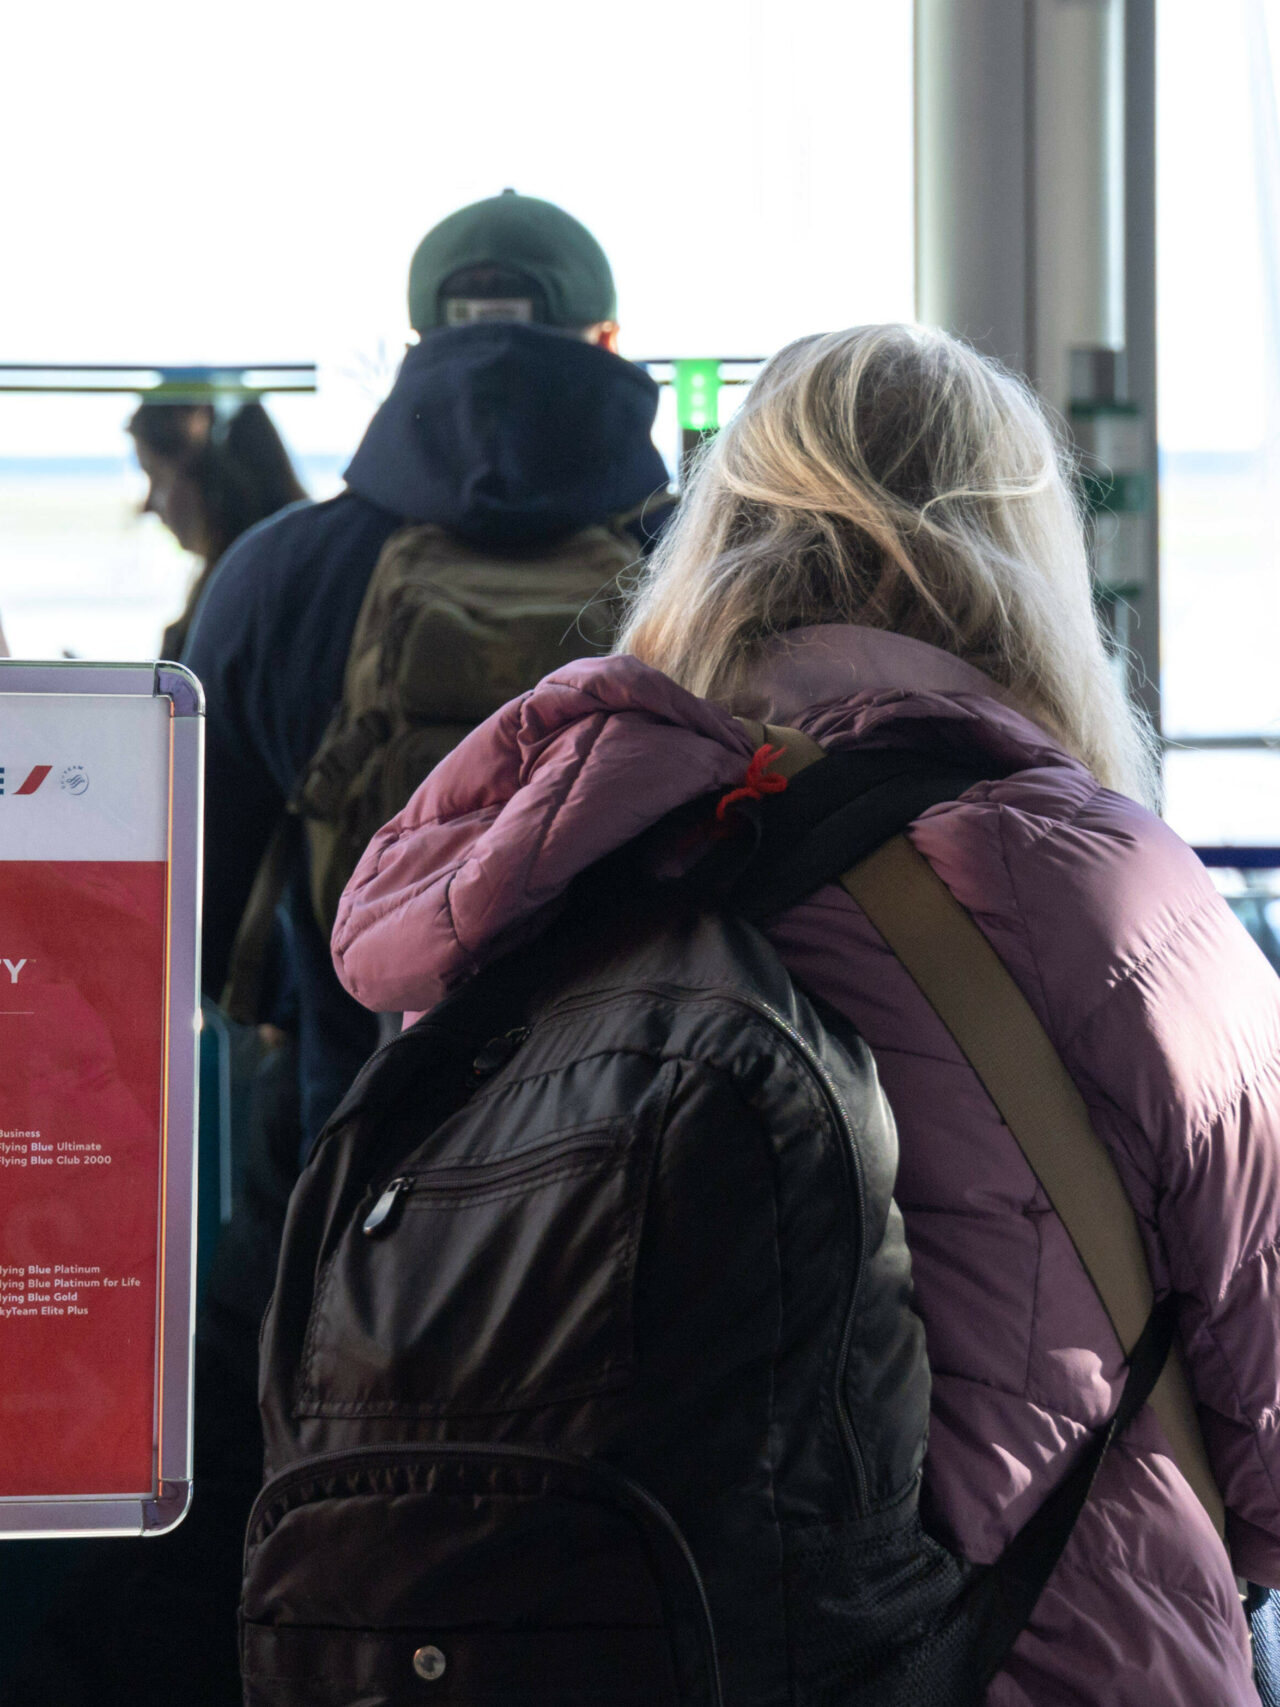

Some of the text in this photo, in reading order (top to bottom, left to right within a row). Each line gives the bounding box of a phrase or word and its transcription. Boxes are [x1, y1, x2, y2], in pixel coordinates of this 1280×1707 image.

[31, 1142, 54, 1152] Blue
[57, 1141, 102, 1151] Ultimate
[30, 1156, 53, 1165] Blue
[56, 1155, 81, 1165] Club
[84, 1155, 112, 1164] 2000
[28, 1265, 51, 1274] Blue
[54, 1264, 100, 1274] Platinum
[28, 1279, 51, 1288] Blue
[54, 1278, 100, 1288] Platinum
[103, 1278, 119, 1287] for
[121, 1277, 141, 1287] Life
[27, 1293, 51, 1302] Blue
[53, 1292, 79, 1301] Gold
[41, 1306, 65, 1315] Elite
[67, 1306, 89, 1315] Plus
